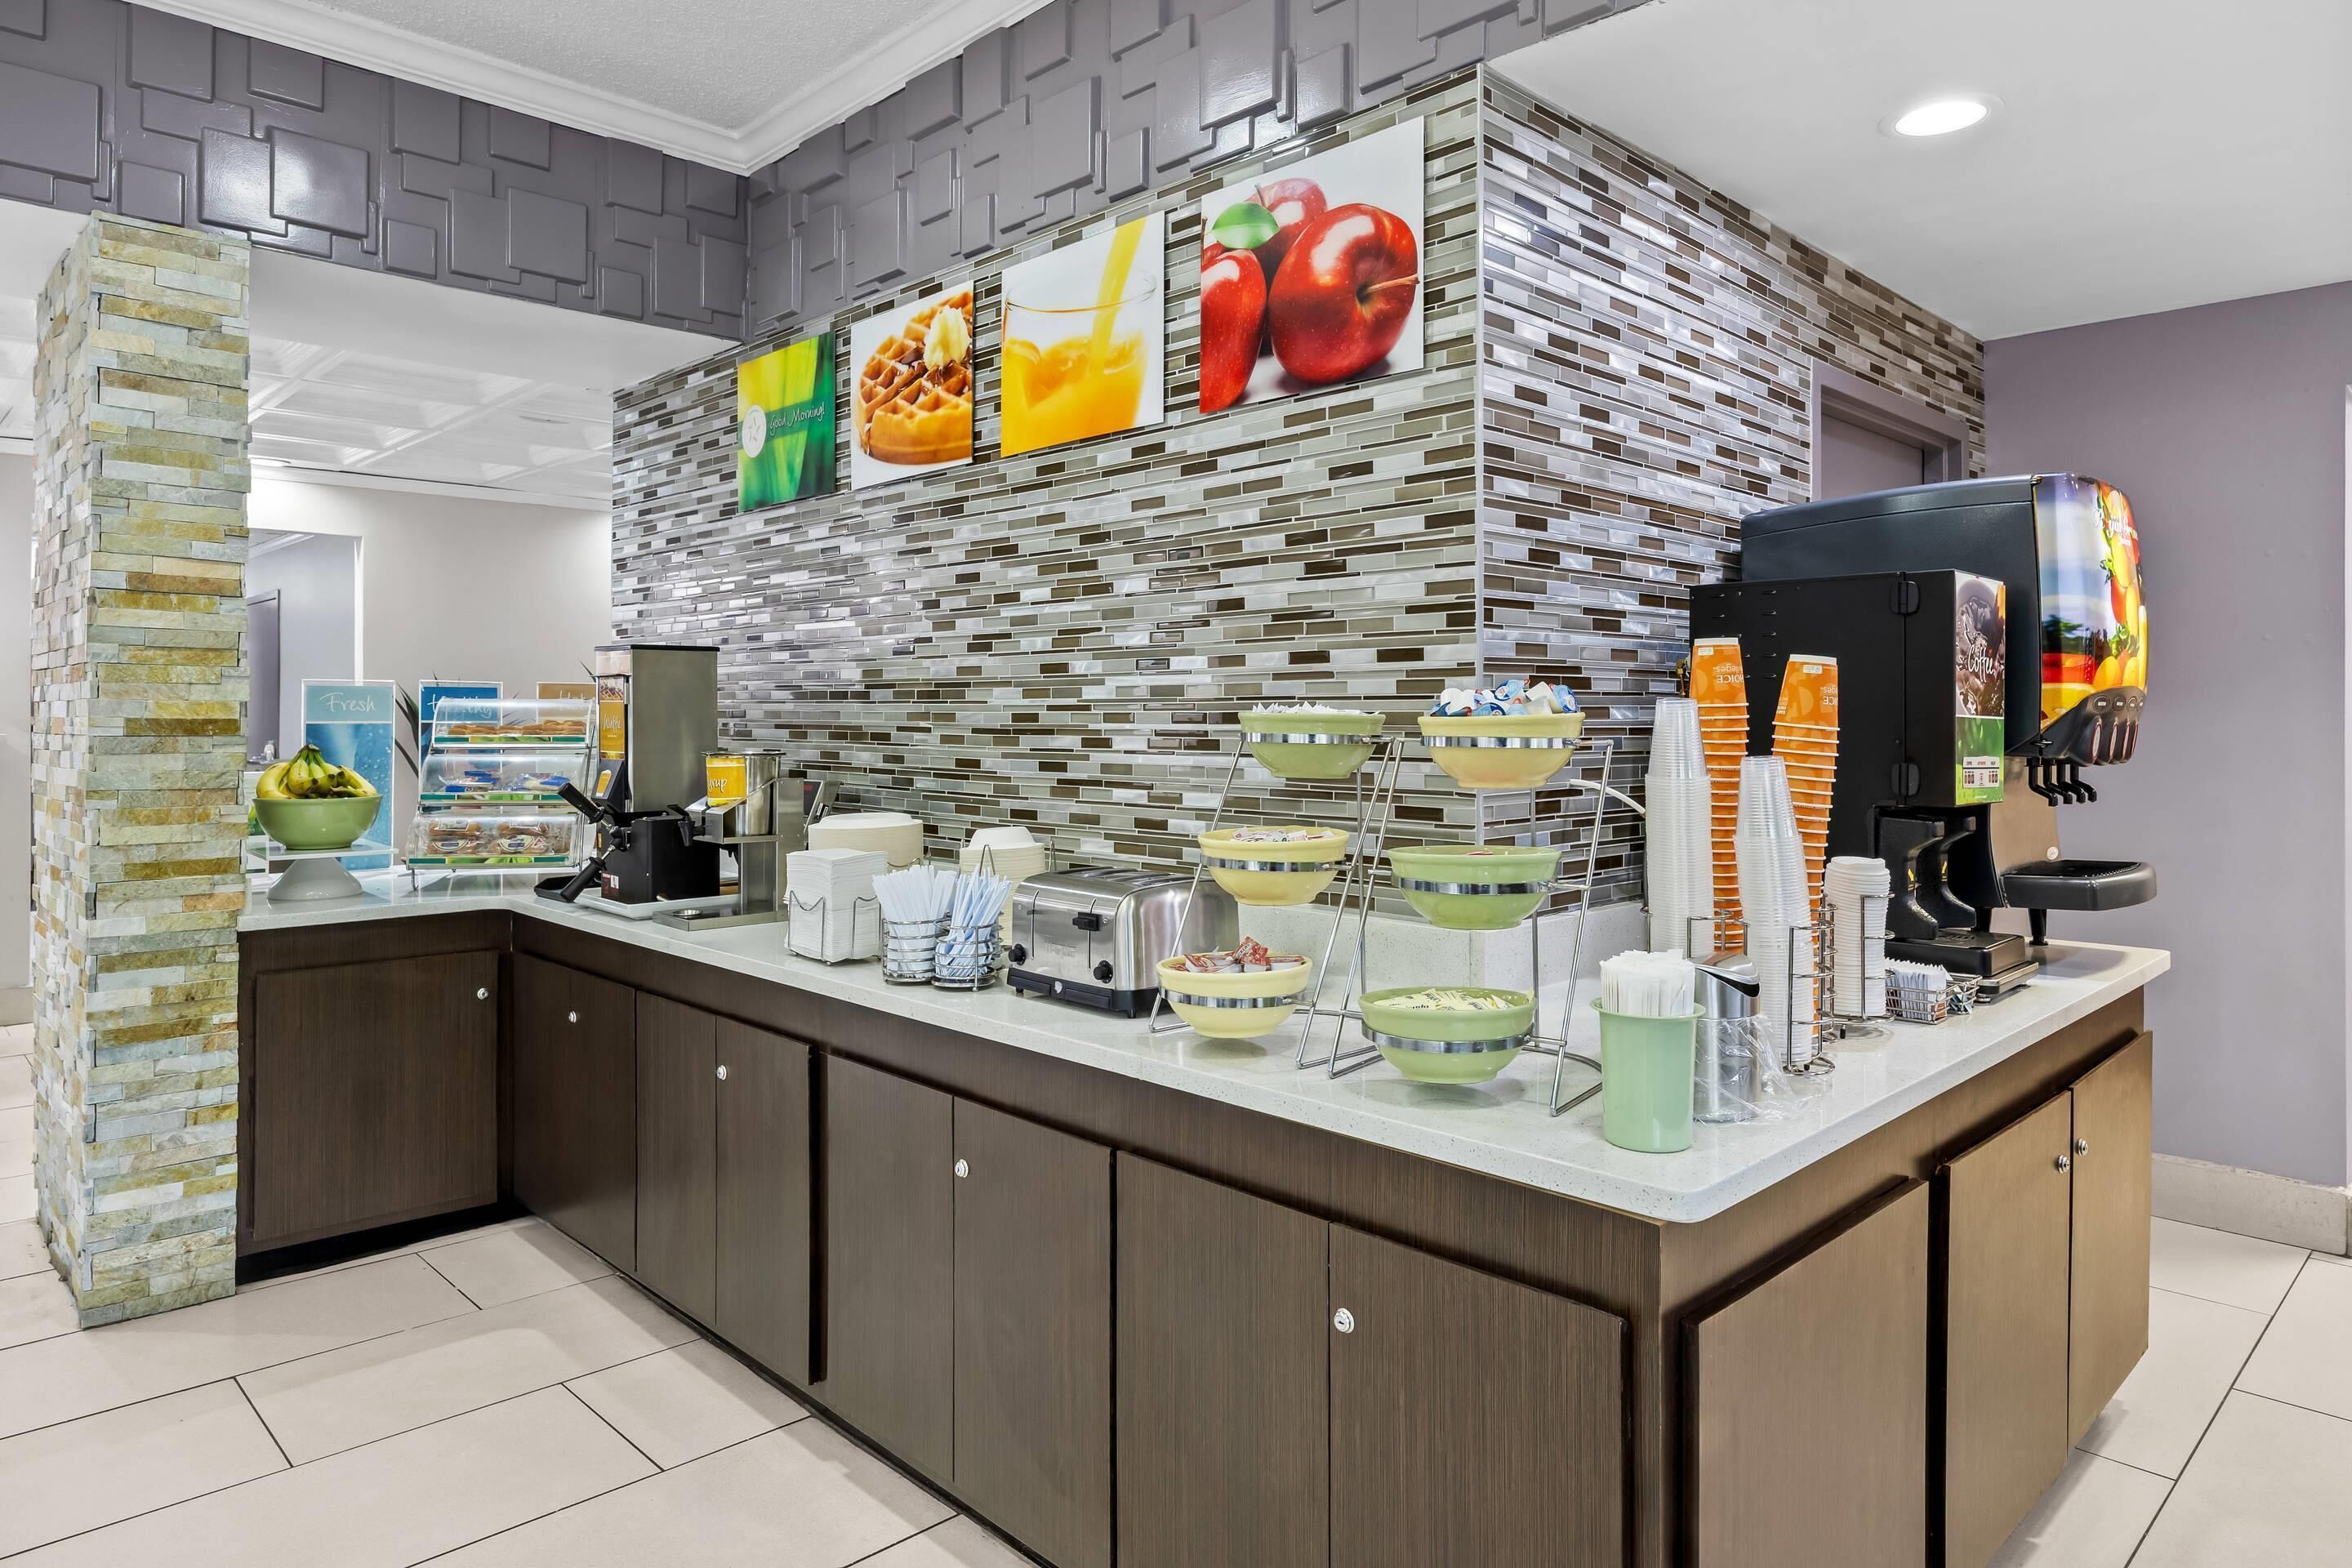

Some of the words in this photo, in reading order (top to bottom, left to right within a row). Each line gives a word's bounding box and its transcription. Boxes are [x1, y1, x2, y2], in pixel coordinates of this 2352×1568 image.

[770, 412, 786, 436] Good
[788, 401, 825, 426] Morning!
[1968, 644, 1994, 683] Coffee
[319, 692, 376, 713] Fresh
